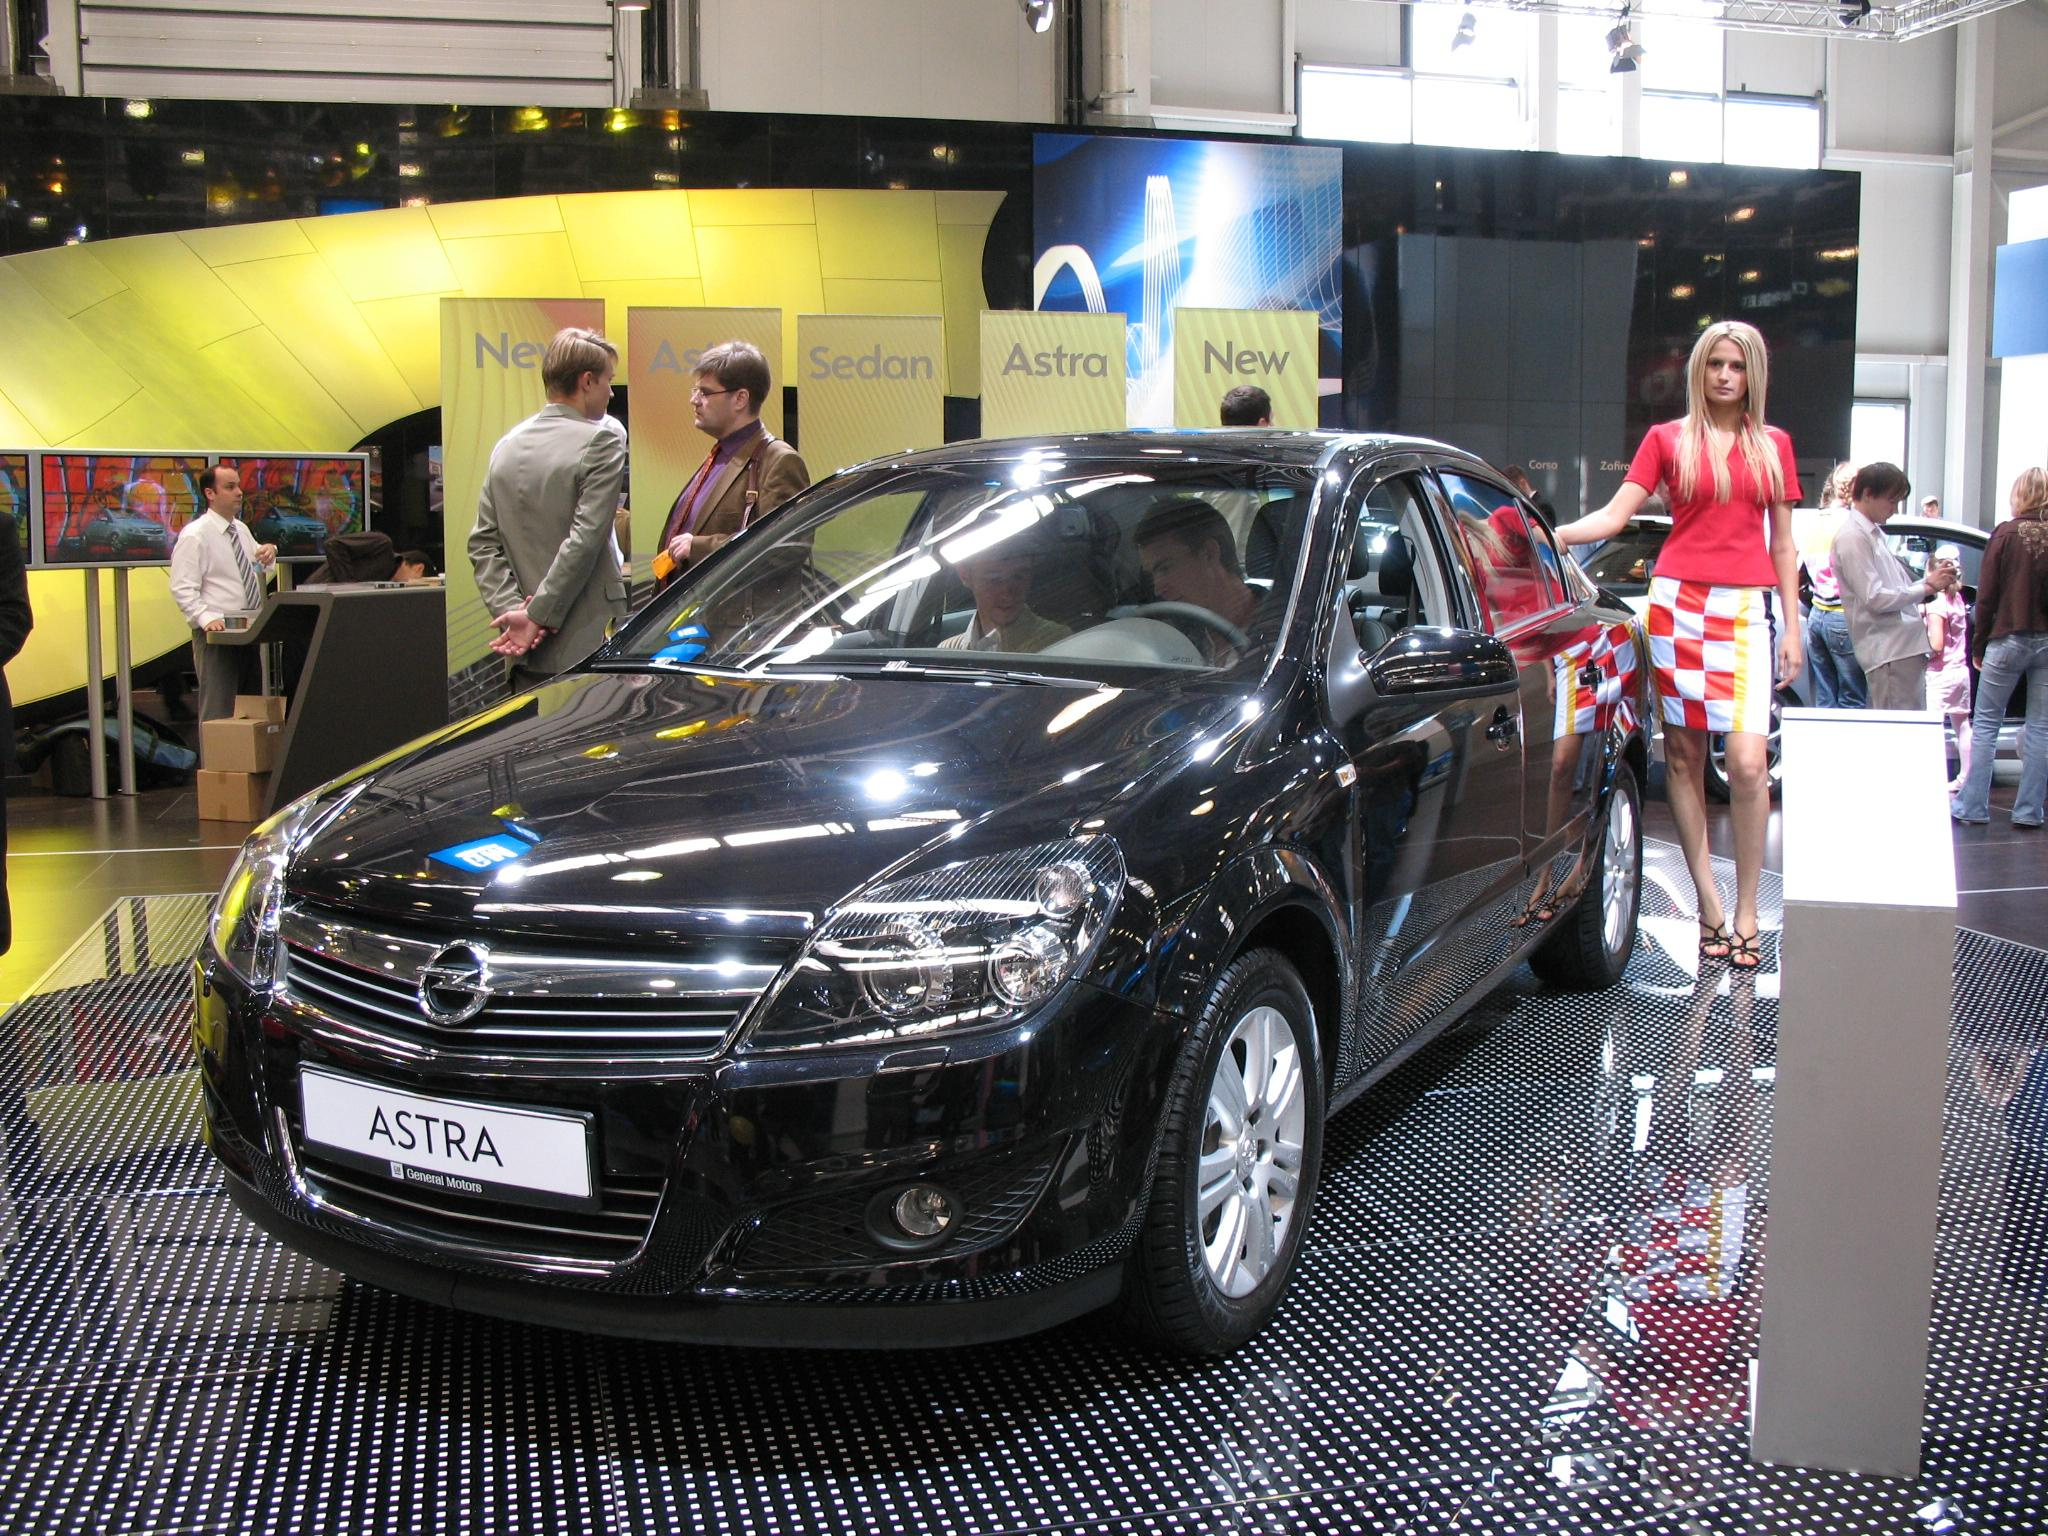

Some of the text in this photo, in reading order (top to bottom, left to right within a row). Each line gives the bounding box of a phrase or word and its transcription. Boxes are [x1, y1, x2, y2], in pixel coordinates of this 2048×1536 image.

[809, 343, 934, 380] Sedan
[1001, 342, 1108, 377] Astra
[1204, 340, 1290, 375] New
[1528, 459, 1558, 470] Corsa
[1599, 460, 1631, 471] Zafira
[368, 1105, 504, 1167] ASTRA
[406, 1168, 444, 1185] General
[446, 1176, 483, 1193] Motors
